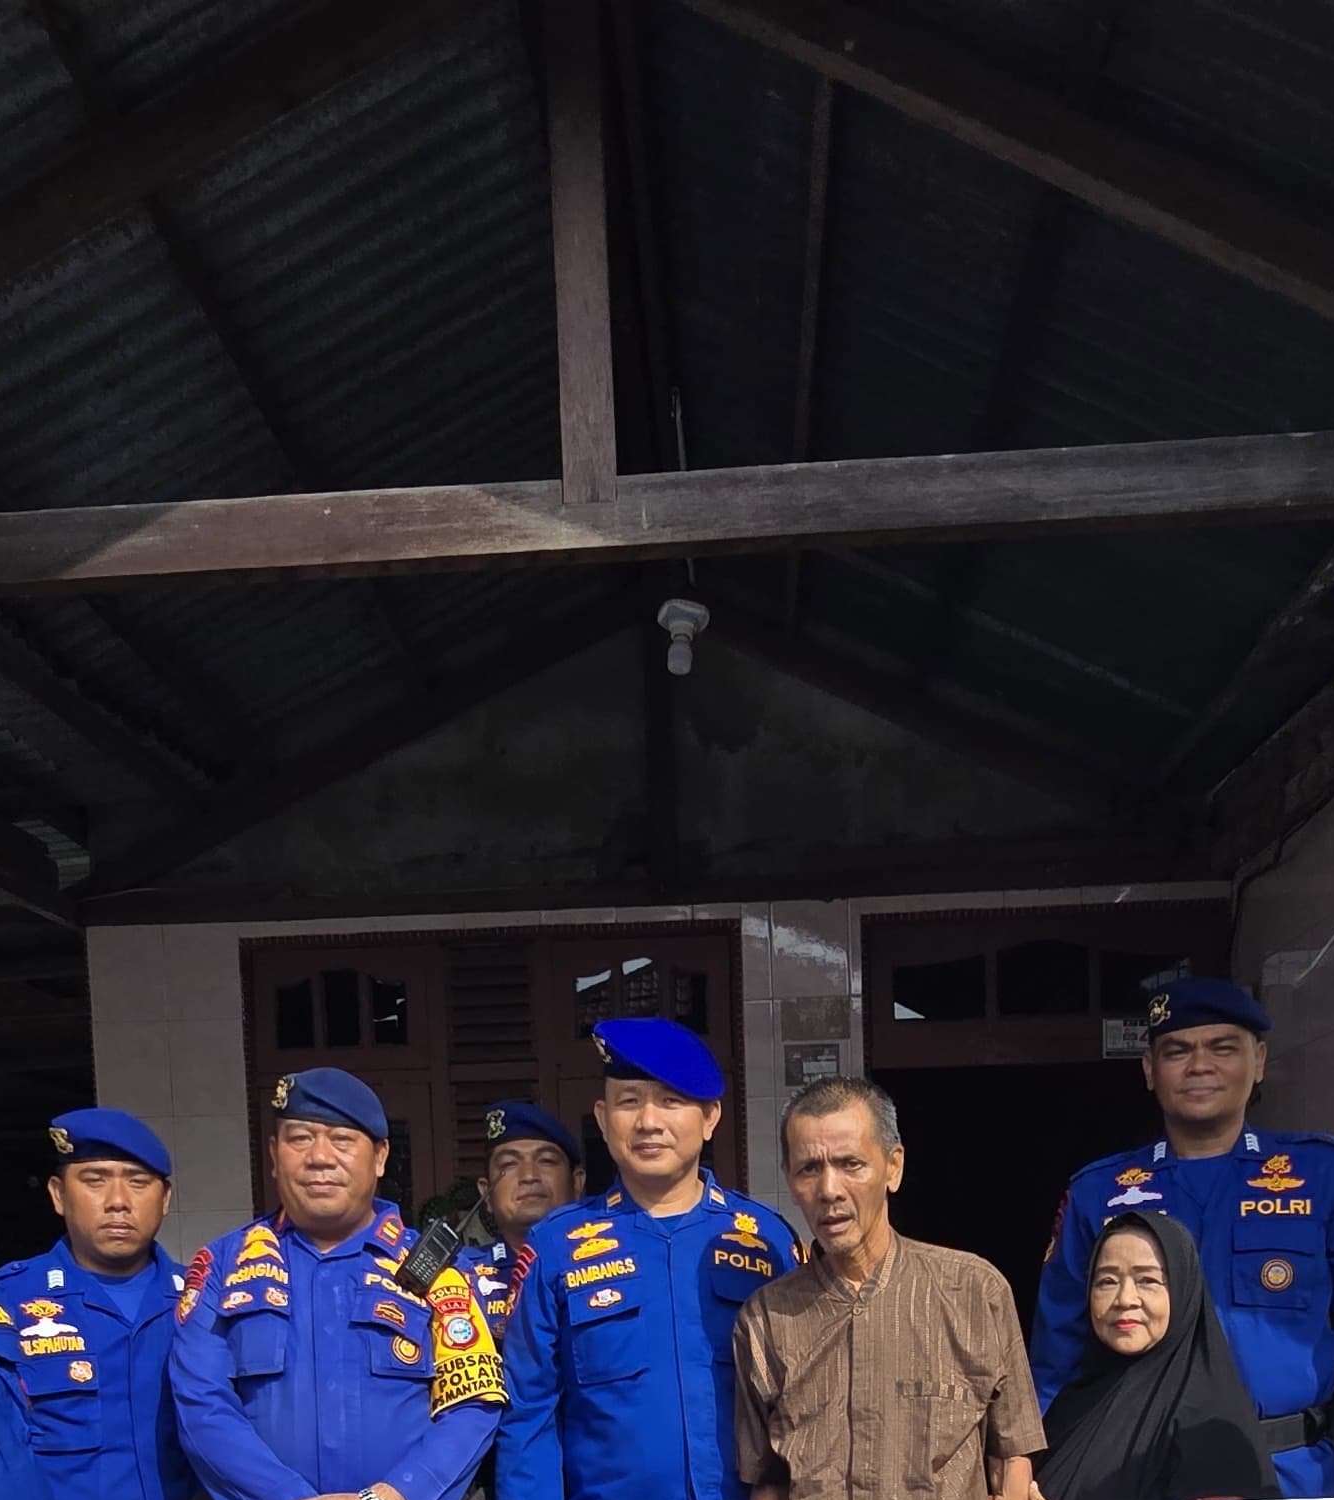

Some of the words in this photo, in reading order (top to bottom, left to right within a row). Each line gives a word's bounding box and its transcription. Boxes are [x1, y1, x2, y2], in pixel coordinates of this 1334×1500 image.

[1241, 1199, 1311, 1216] POLRI
[567, 1258, 636, 1288] BAMBANG.S
[715, 1250, 772, 1277] POLRI
[446, 1380, 494, 1403] MANTAP
